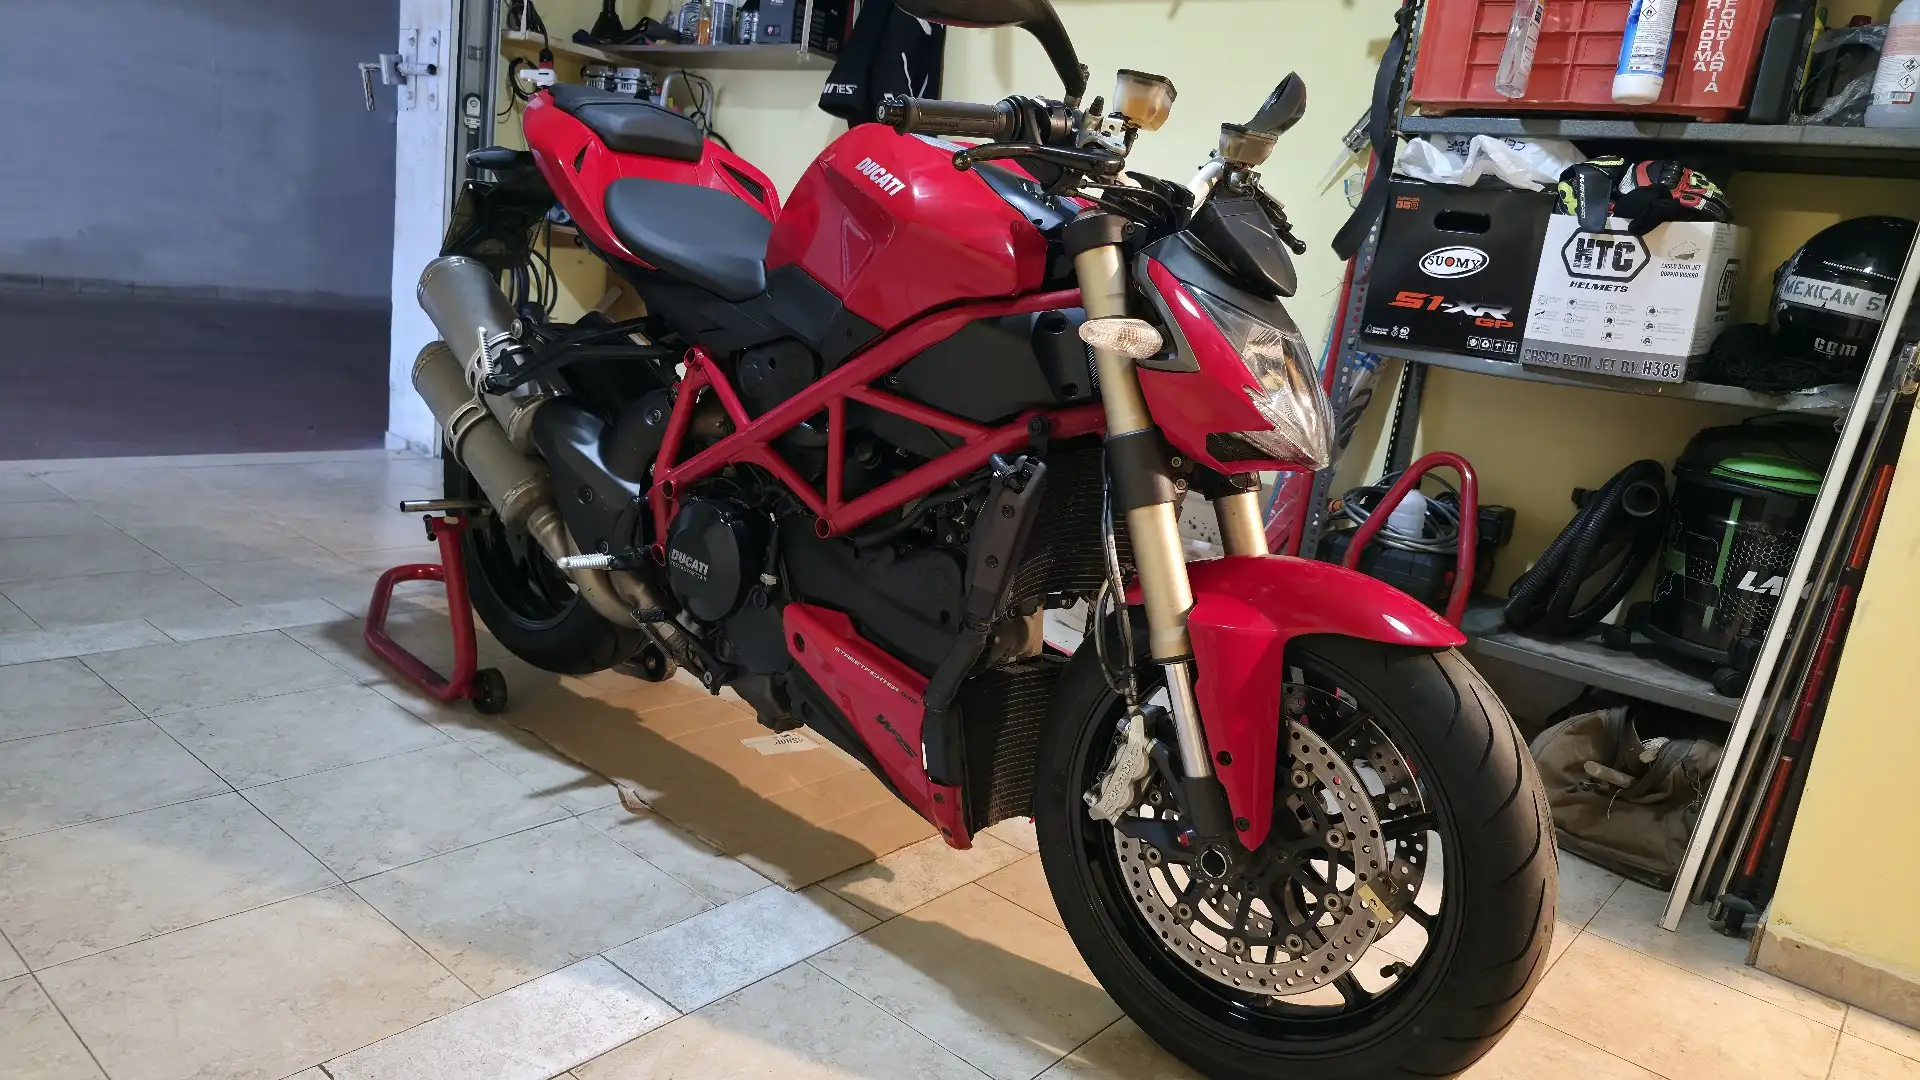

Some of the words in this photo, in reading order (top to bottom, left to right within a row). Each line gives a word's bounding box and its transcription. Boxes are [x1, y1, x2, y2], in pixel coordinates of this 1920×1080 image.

[1693, 0, 1721, 72] RIFORMA
[1703, 0, 1738, 93] FONDIARIA
[855, 157, 906, 197] DUCATI
[1427, 255, 1480, 271] SUOMY
[1573, 238, 1636, 272] HTC
[1569, 281, 1629, 293] HELMETS
[1782, 279, 1860, 307] MEXICAN
[1388, 291, 1513, 320] S1-XR
[1474, 317, 1515, 329] GP
[1523, 348, 1560, 365] CASCO
[1563, 353, 1592, 370] DEMI
[1595, 357, 1617, 372] JET
[1642, 360, 1681, 379] H385
[671, 549, 709, 576] DUCATI
